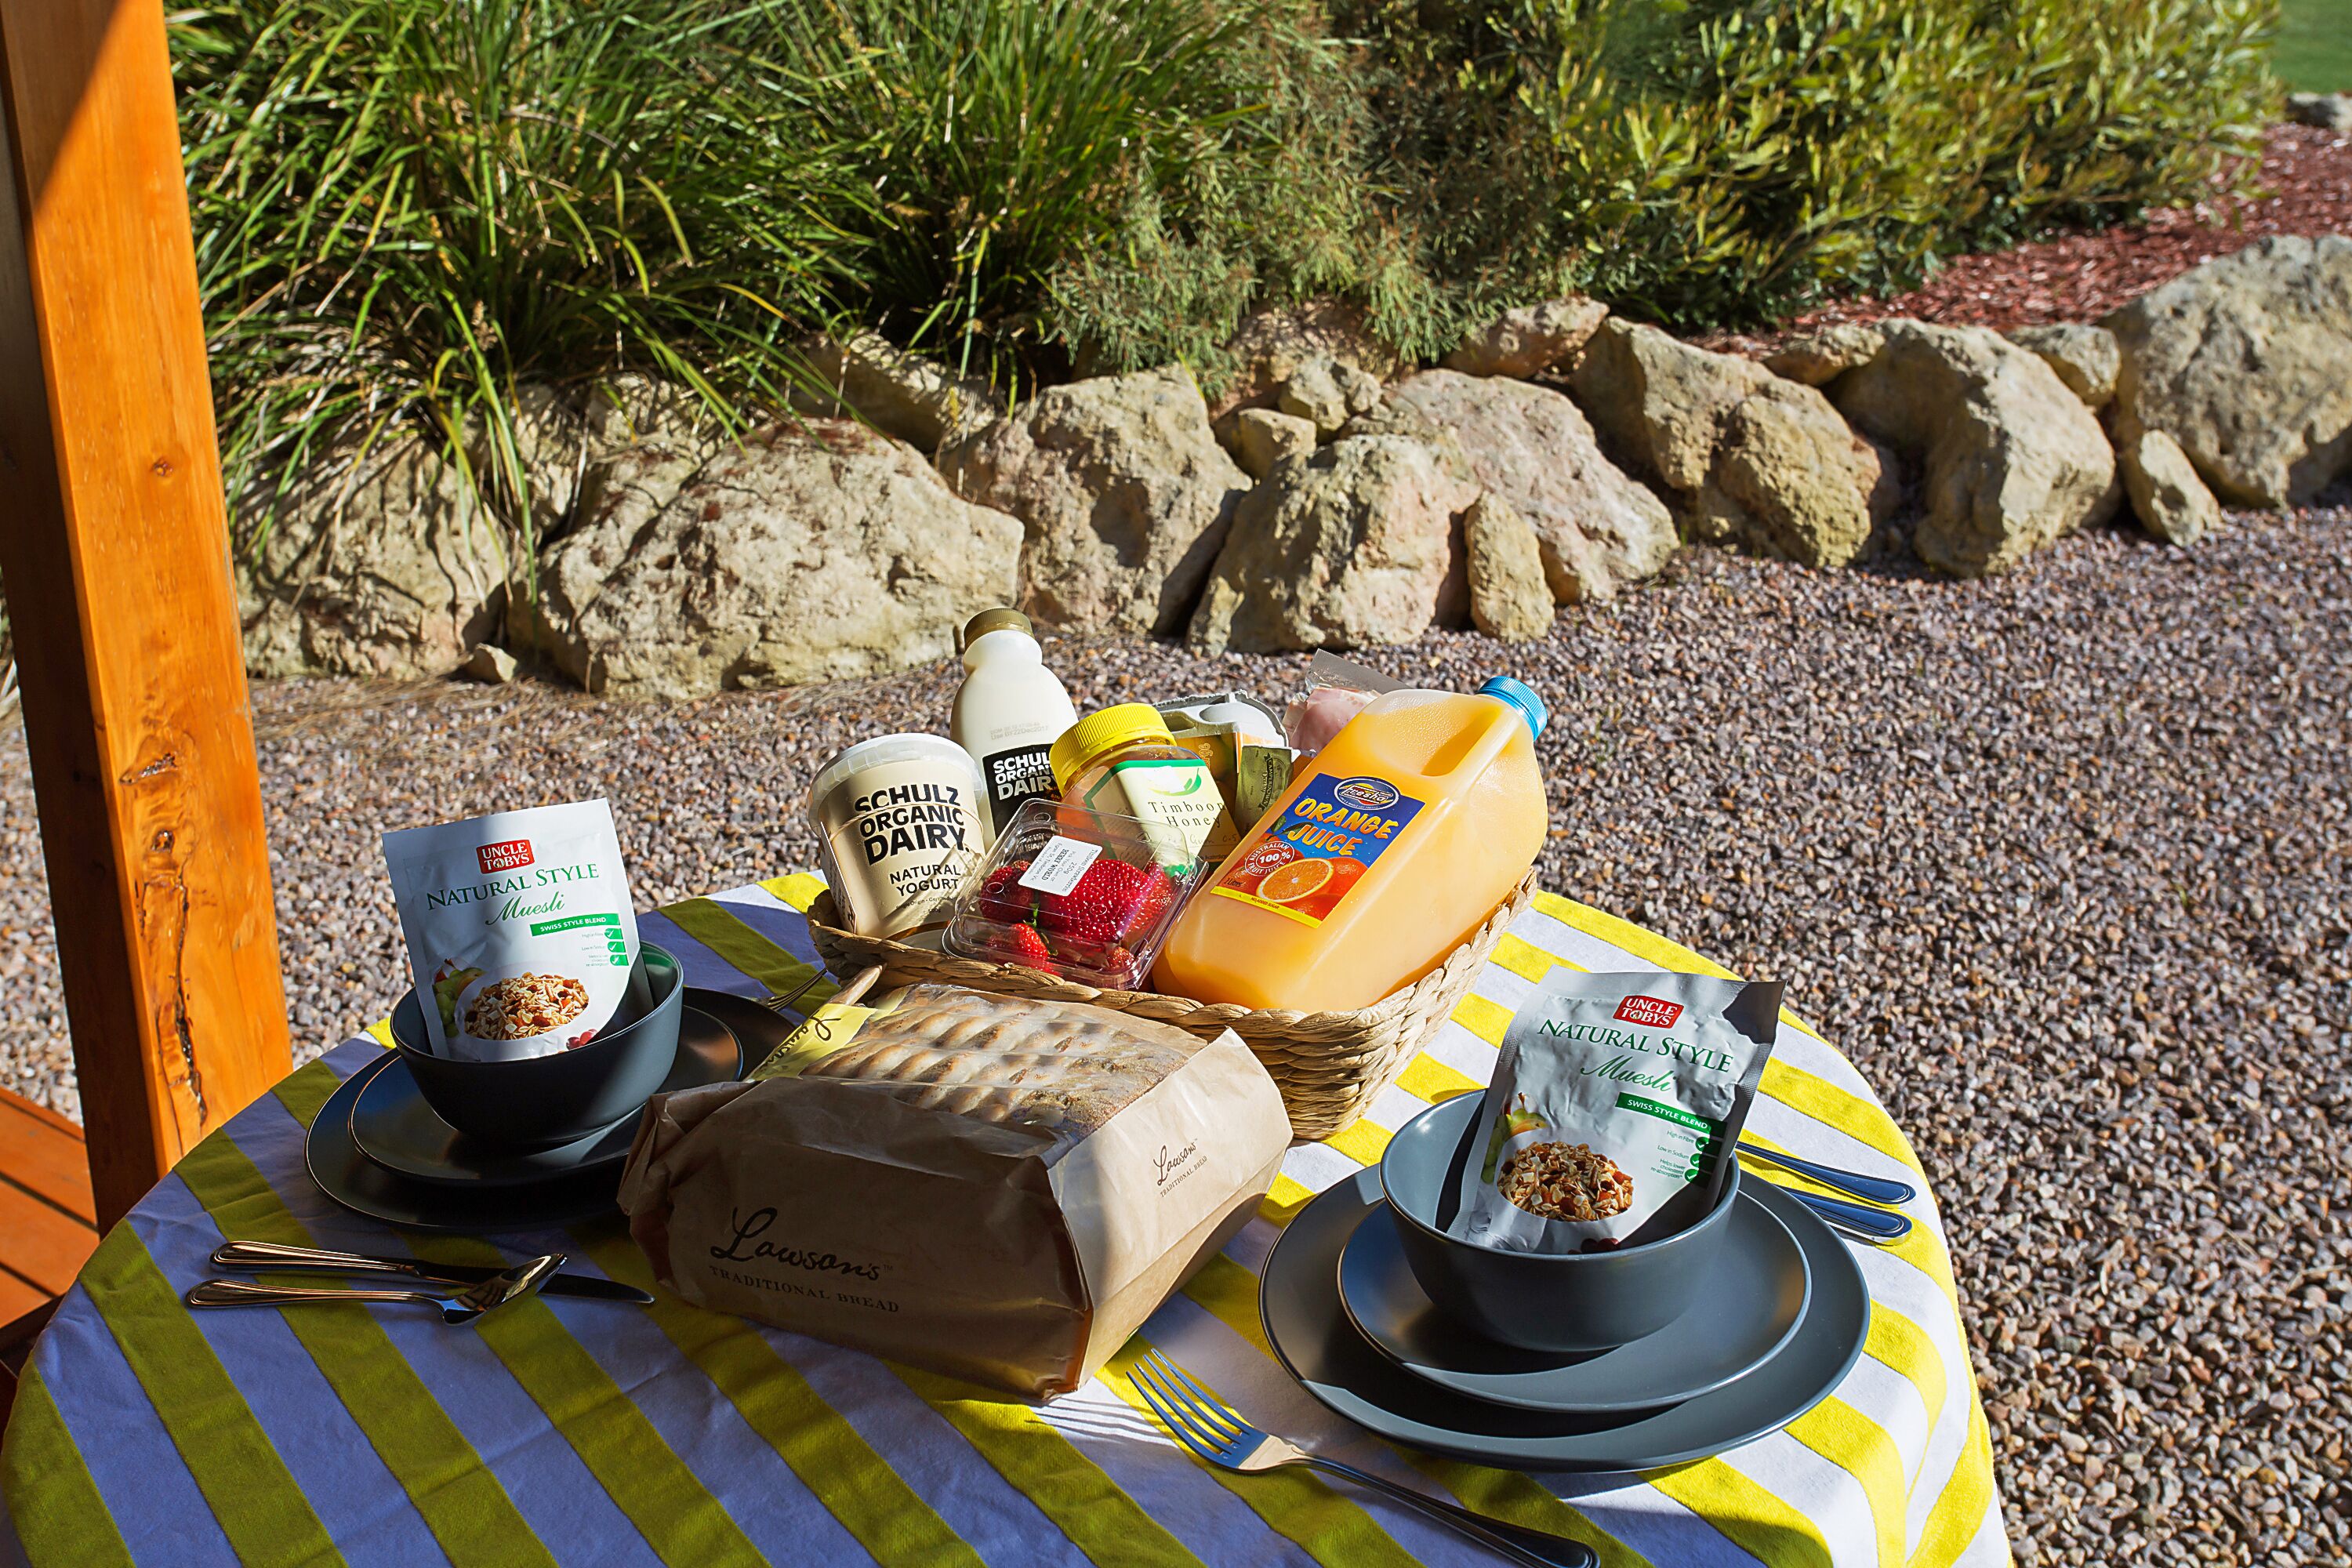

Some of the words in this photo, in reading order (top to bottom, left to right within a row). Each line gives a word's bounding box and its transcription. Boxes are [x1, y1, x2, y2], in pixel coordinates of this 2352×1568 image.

[993, 752, 1051, 774] SCHUL
[995, 764, 1054, 784] ORGAN
[1263, 760, 1273, 804] CAMPERDOWN
[855, 784, 960, 812] SCHULZ
[1148, 801, 1226, 814] Timboon
[859, 805, 964, 838] ORGANIC
[1166, 815, 1221, 828] Honey
[1294, 798, 1399, 839] ORANGE
[481, 842, 527, 858] UNCLE
[1250, 843, 1290, 861] AUSTRALIAN
[1287, 824, 1363, 856] JUICE
[485, 853, 530, 870] TOBYS
[890, 864, 961, 884] NATURAL
[1248, 862, 1265, 874] FRUIT
[426, 875, 532, 911] NATURAL
[535, 863, 600, 887] STYLE
[896, 878, 959, 897] YOGURT
[485, 891, 565, 925] Muesli
[540, 923, 562, 932] SWISS
[563, 918, 583, 927] STYLE
[1622, 1007, 1671, 1026] TOBYS
[1625, 998, 1678, 1016] UNCLE
[1537, 1018, 1650, 1053] NATURAL
[1657, 1037, 1734, 1073] STYLE
[1580, 1054, 1678, 1091] Muesli
[1627, 1099, 1653, 1111] SWISS
[1654, 1106, 1679, 1119] STYLE
[1680, 1116, 1708, 1129] BLEND
[1160, 1168, 1194, 1198] TRADITIONAL
[1193, 1156, 1207, 1171] BREAD
[710, 1207, 880, 1281] Lawson's
[709, 1265, 831, 1300] TRADITIONAL
[838, 1293, 899, 1313] BREAD
